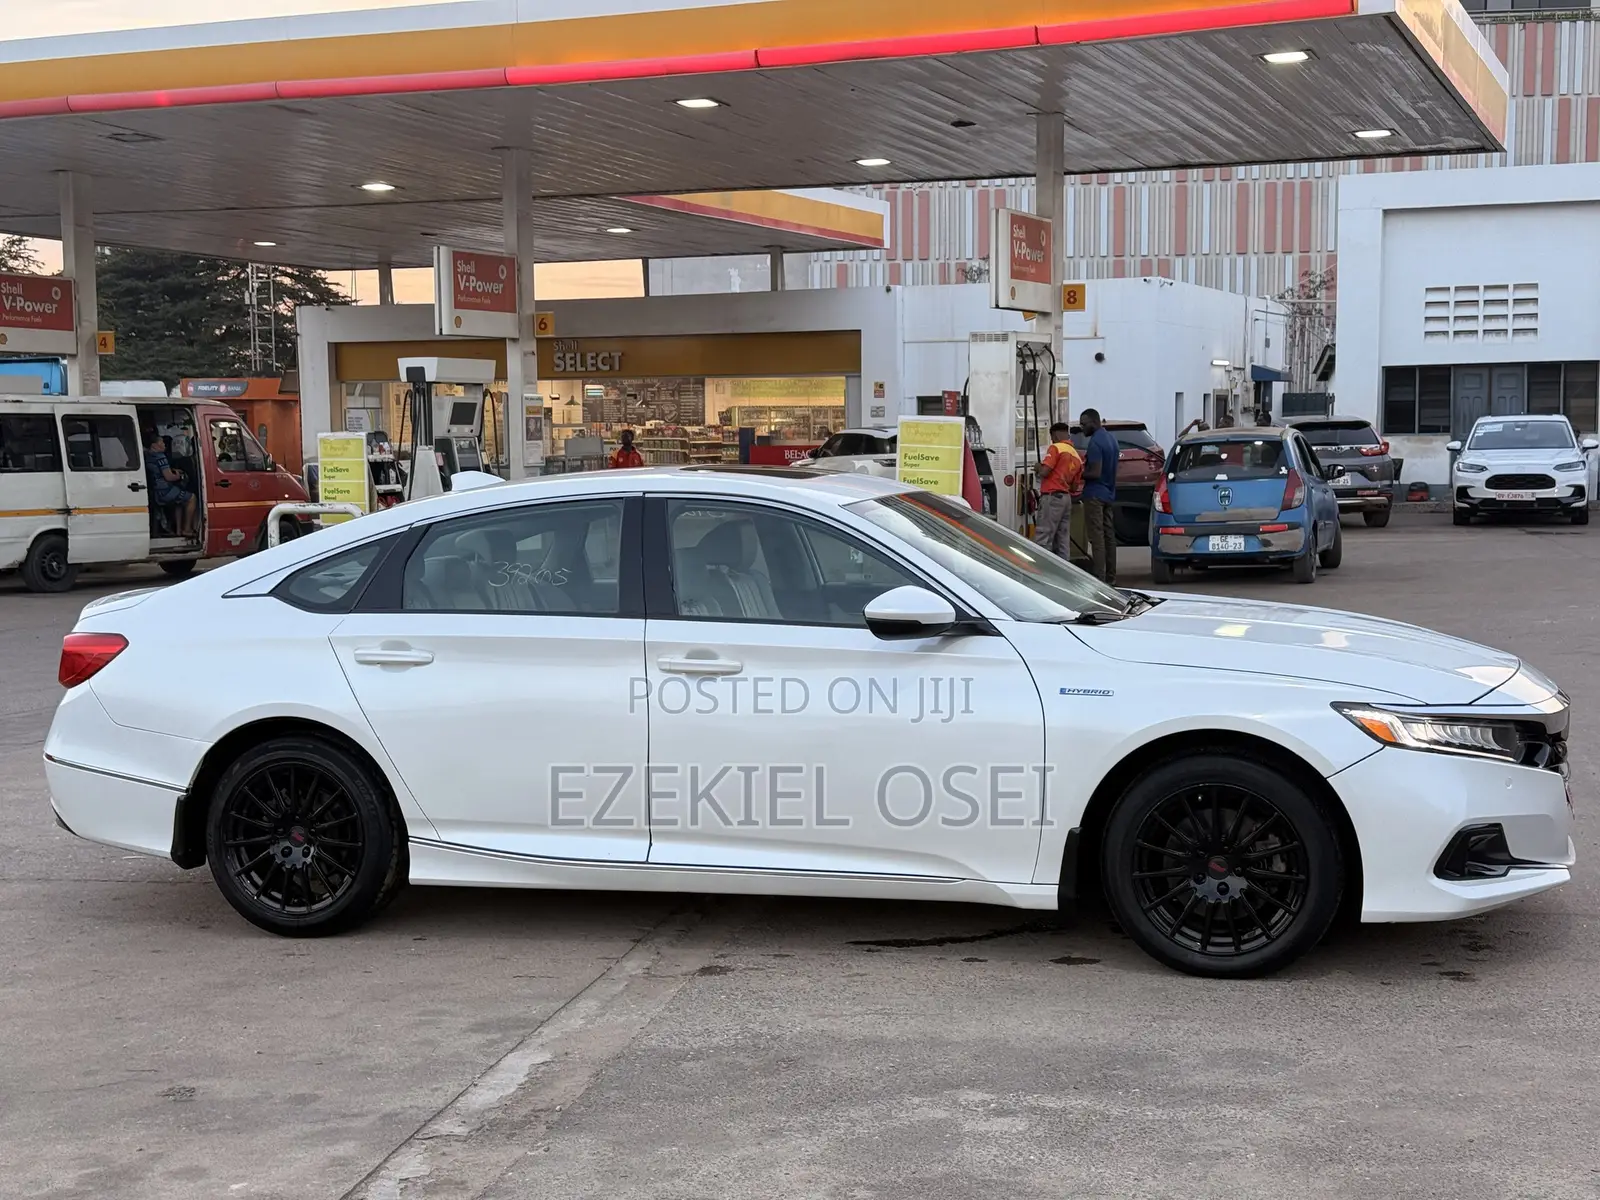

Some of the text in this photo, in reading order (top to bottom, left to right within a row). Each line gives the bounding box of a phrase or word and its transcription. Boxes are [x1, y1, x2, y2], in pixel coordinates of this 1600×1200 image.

[1013, 224, 1026, 239] Shell
[1013, 239, 1044, 263] V-Power
[457, 260, 475, 274] Shell
[0, 282, 23, 294] Shell
[457, 274, 504, 294] V-Power
[1066, 289, 1078, 305] 8
[2, 295, 58, 314] V-Power
[538, 317, 548, 331] 6
[99, 336, 107, 349] 4
[553, 340, 579, 351] Shell
[553, 352, 623, 372] SELECT
[903, 453, 940, 461] FuelSave
[902, 477, 939, 485] FuelSave
[1220, 535, 1229, 543] GE
